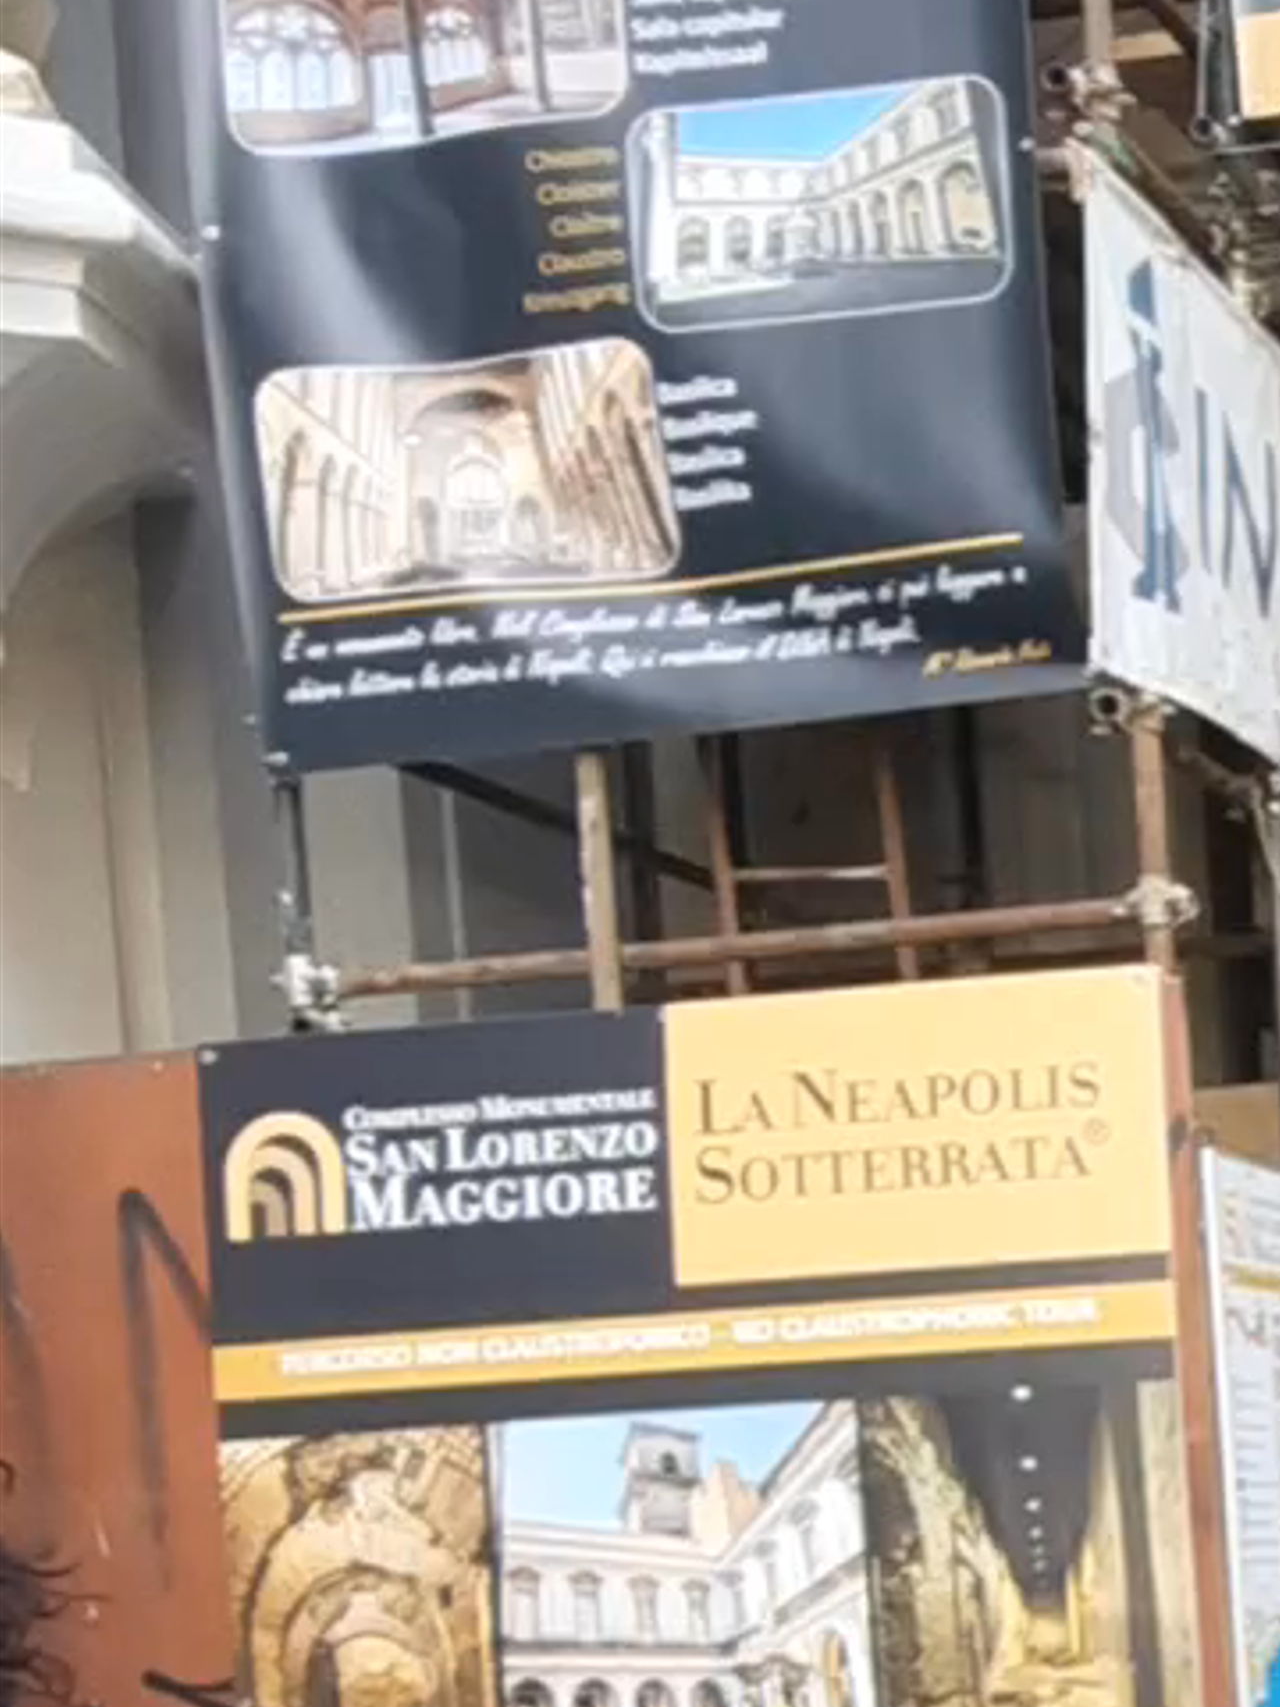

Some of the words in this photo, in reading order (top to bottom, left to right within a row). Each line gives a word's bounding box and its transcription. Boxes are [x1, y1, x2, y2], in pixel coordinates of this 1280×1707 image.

[694, 1078, 773, 1135] LA
[791, 1060, 1101, 1128] NEAPOLIS
[346, 1132, 437, 1179] SAN
[445, 1121, 658, 1171] LORENZO
[350, 1167, 657, 1231] MAGGIORE
